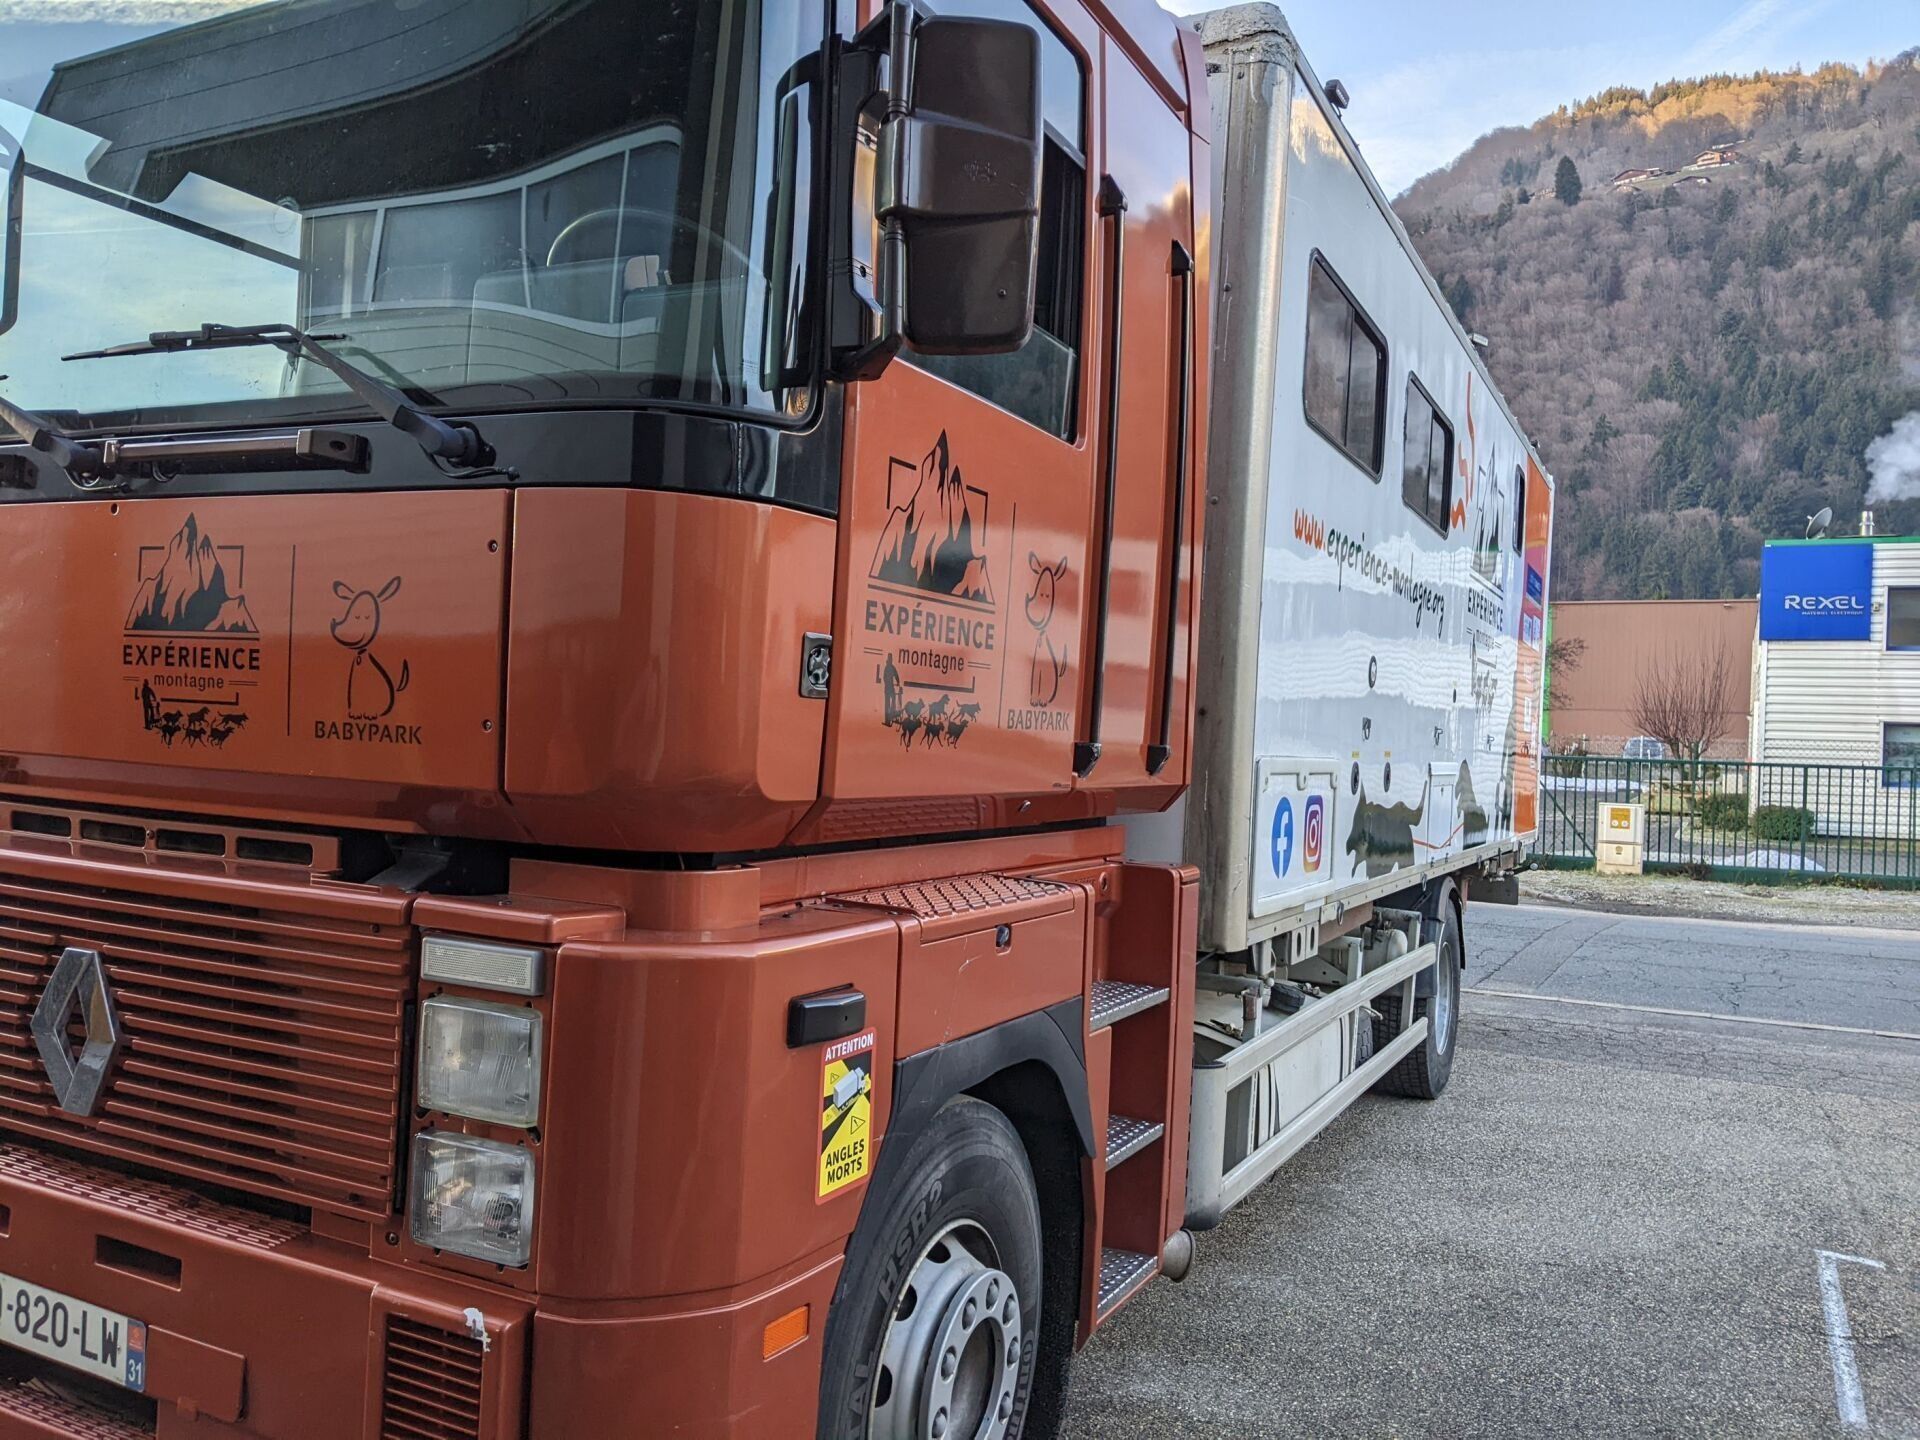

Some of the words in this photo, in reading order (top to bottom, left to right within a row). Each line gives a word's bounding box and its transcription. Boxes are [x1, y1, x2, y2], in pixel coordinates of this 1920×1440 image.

[1784, 595, 1864, 609] REXEL
[865, 600, 995, 650] EXPÉRIENCE
[123, 640, 260, 671] EXPÉRIENCE
[898, 647, 965, 674] montagne
[153, 672, 225, 691] montagne
[314, 720, 422, 745] BABYPARK
[1007, 709, 1070, 731] BABYPARK
[825, 1032, 874, 1062] ATTENTION
[826, 1138, 865, 1169] ANGLES
[827, 1157, 863, 1186] MORTS
[0, 1283, 119, 1368] -820-LW
[128, 1358, 142, 1386] 31
